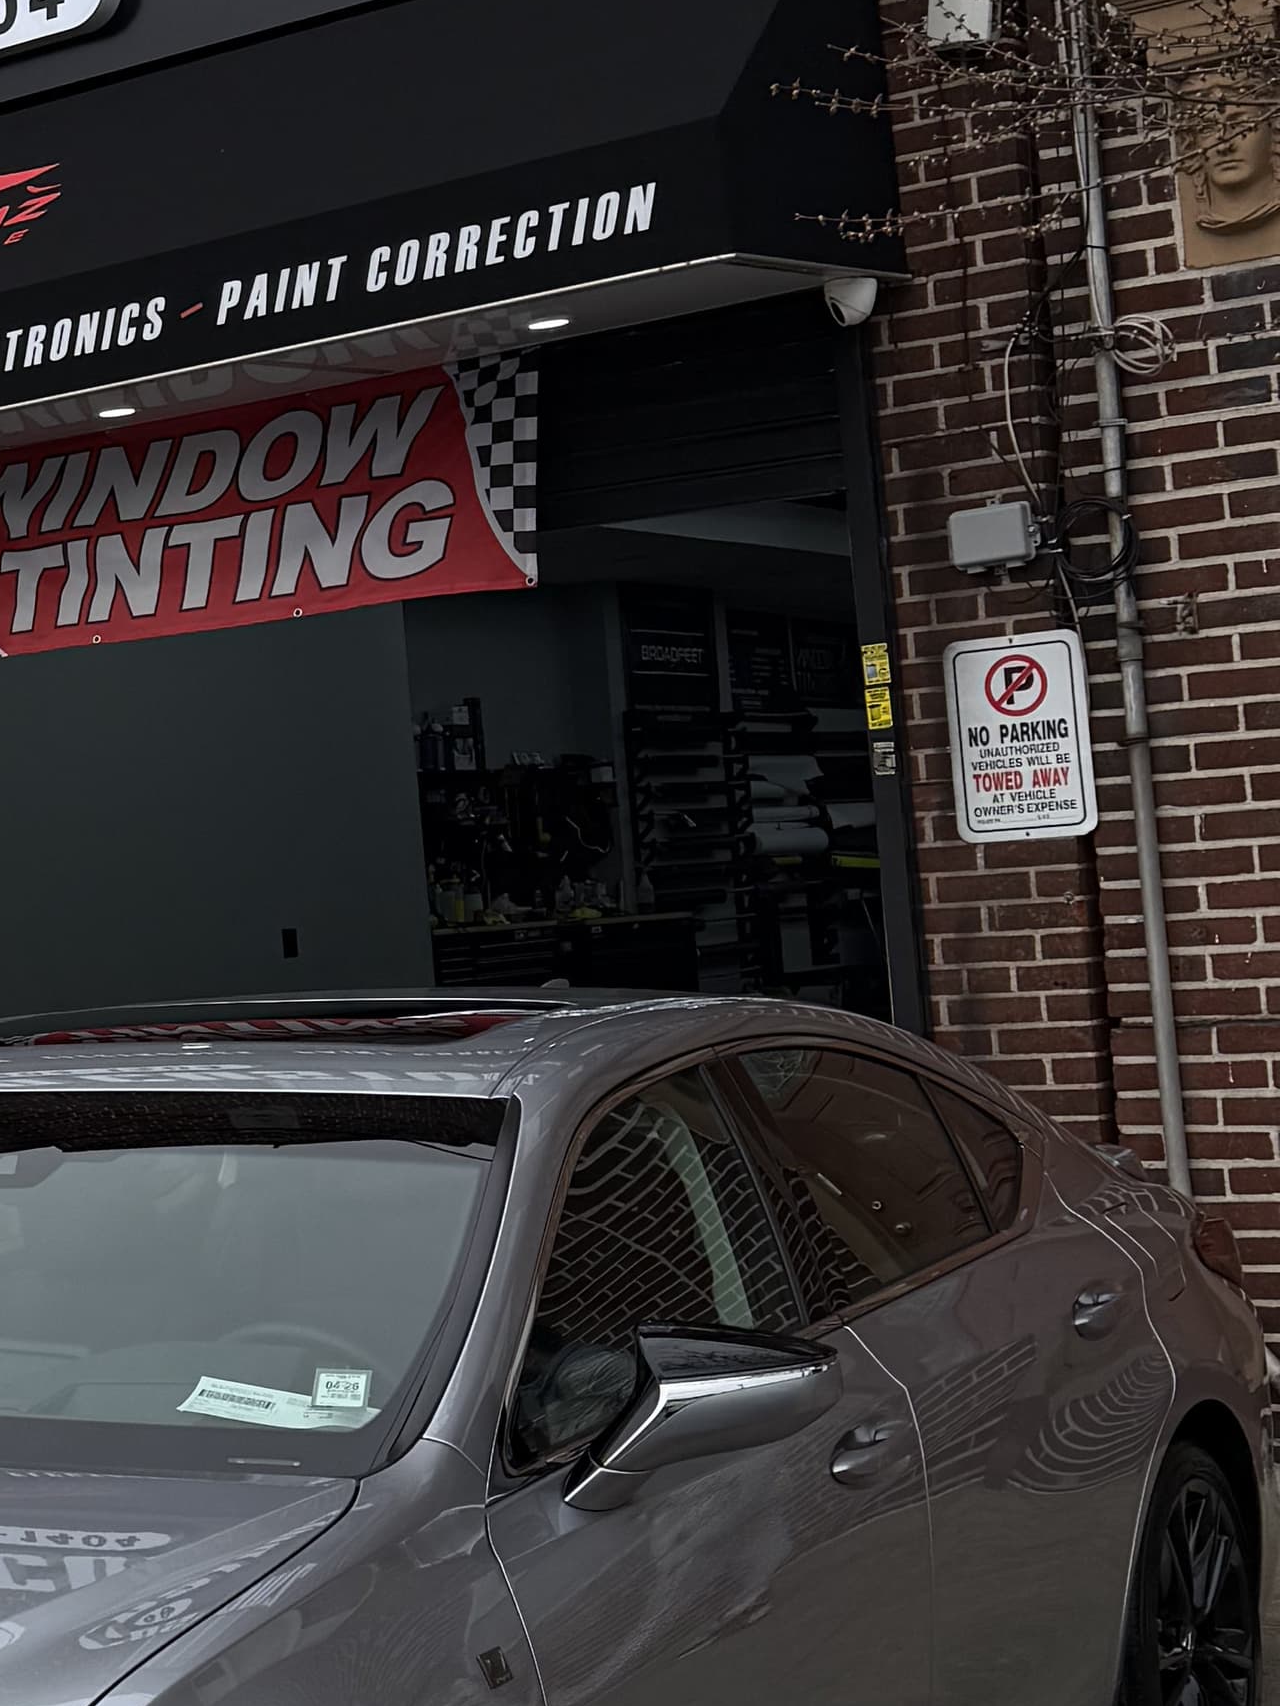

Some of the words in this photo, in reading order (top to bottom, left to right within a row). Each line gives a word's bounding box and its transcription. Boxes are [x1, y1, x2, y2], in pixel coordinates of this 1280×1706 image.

[215, 254, 349, 327] PAINT
[363, 181, 658, 294] CORRECTION
[968, 725, 989, 747] NO
[1000, 718, 1069, 743] PARKING
[979, 742, 1060, 759] UNAUTHORIZED
[971, 757, 1023, 772] VEHICLES
[1027, 755, 1052, 767] WILL
[1056, 753, 1071, 765] BE
[973, 770, 1023, 793] TOWED
[1032, 766, 1070, 788] AWAY
[992, 793, 1005, 804] AT
[1010, 788, 1057, 802] VEHICLE
[973, 802, 1025, 818] OWNER'S
[1026, 799, 1078, 813] EXPENSE
